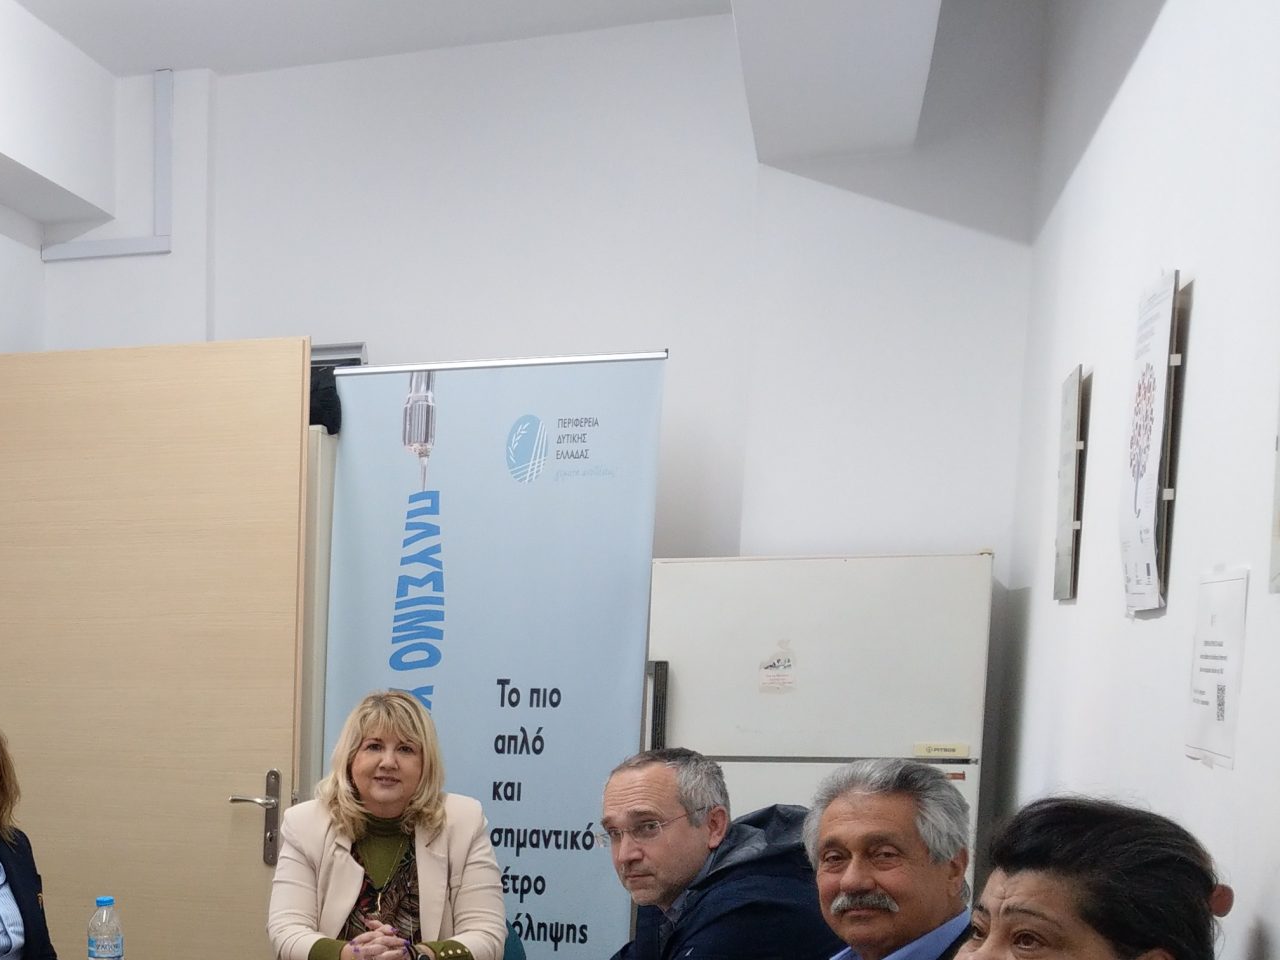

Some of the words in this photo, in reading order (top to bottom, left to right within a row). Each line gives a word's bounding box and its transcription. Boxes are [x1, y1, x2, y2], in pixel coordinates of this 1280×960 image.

[557, 417, 600, 429] ΠΕΡΙΦΕΡΕΙΑ
[556, 433, 588, 444] ΔΥΤΙΚΗΣ
[556, 449, 590, 460] ΕΛΛΑΔΑΣ
[389, 490, 445, 671] ΠΛΥΣΙΜΟ
[496, 678, 521, 708] Το
[529, 687, 562, 708] πιο
[494, 726, 545, 756] απλό
[492, 780, 522, 802] και
[490, 822, 595, 857] σημαντικό
[501, 865, 546, 903] έτρο
[511, 912, 588, 951] όληψης
